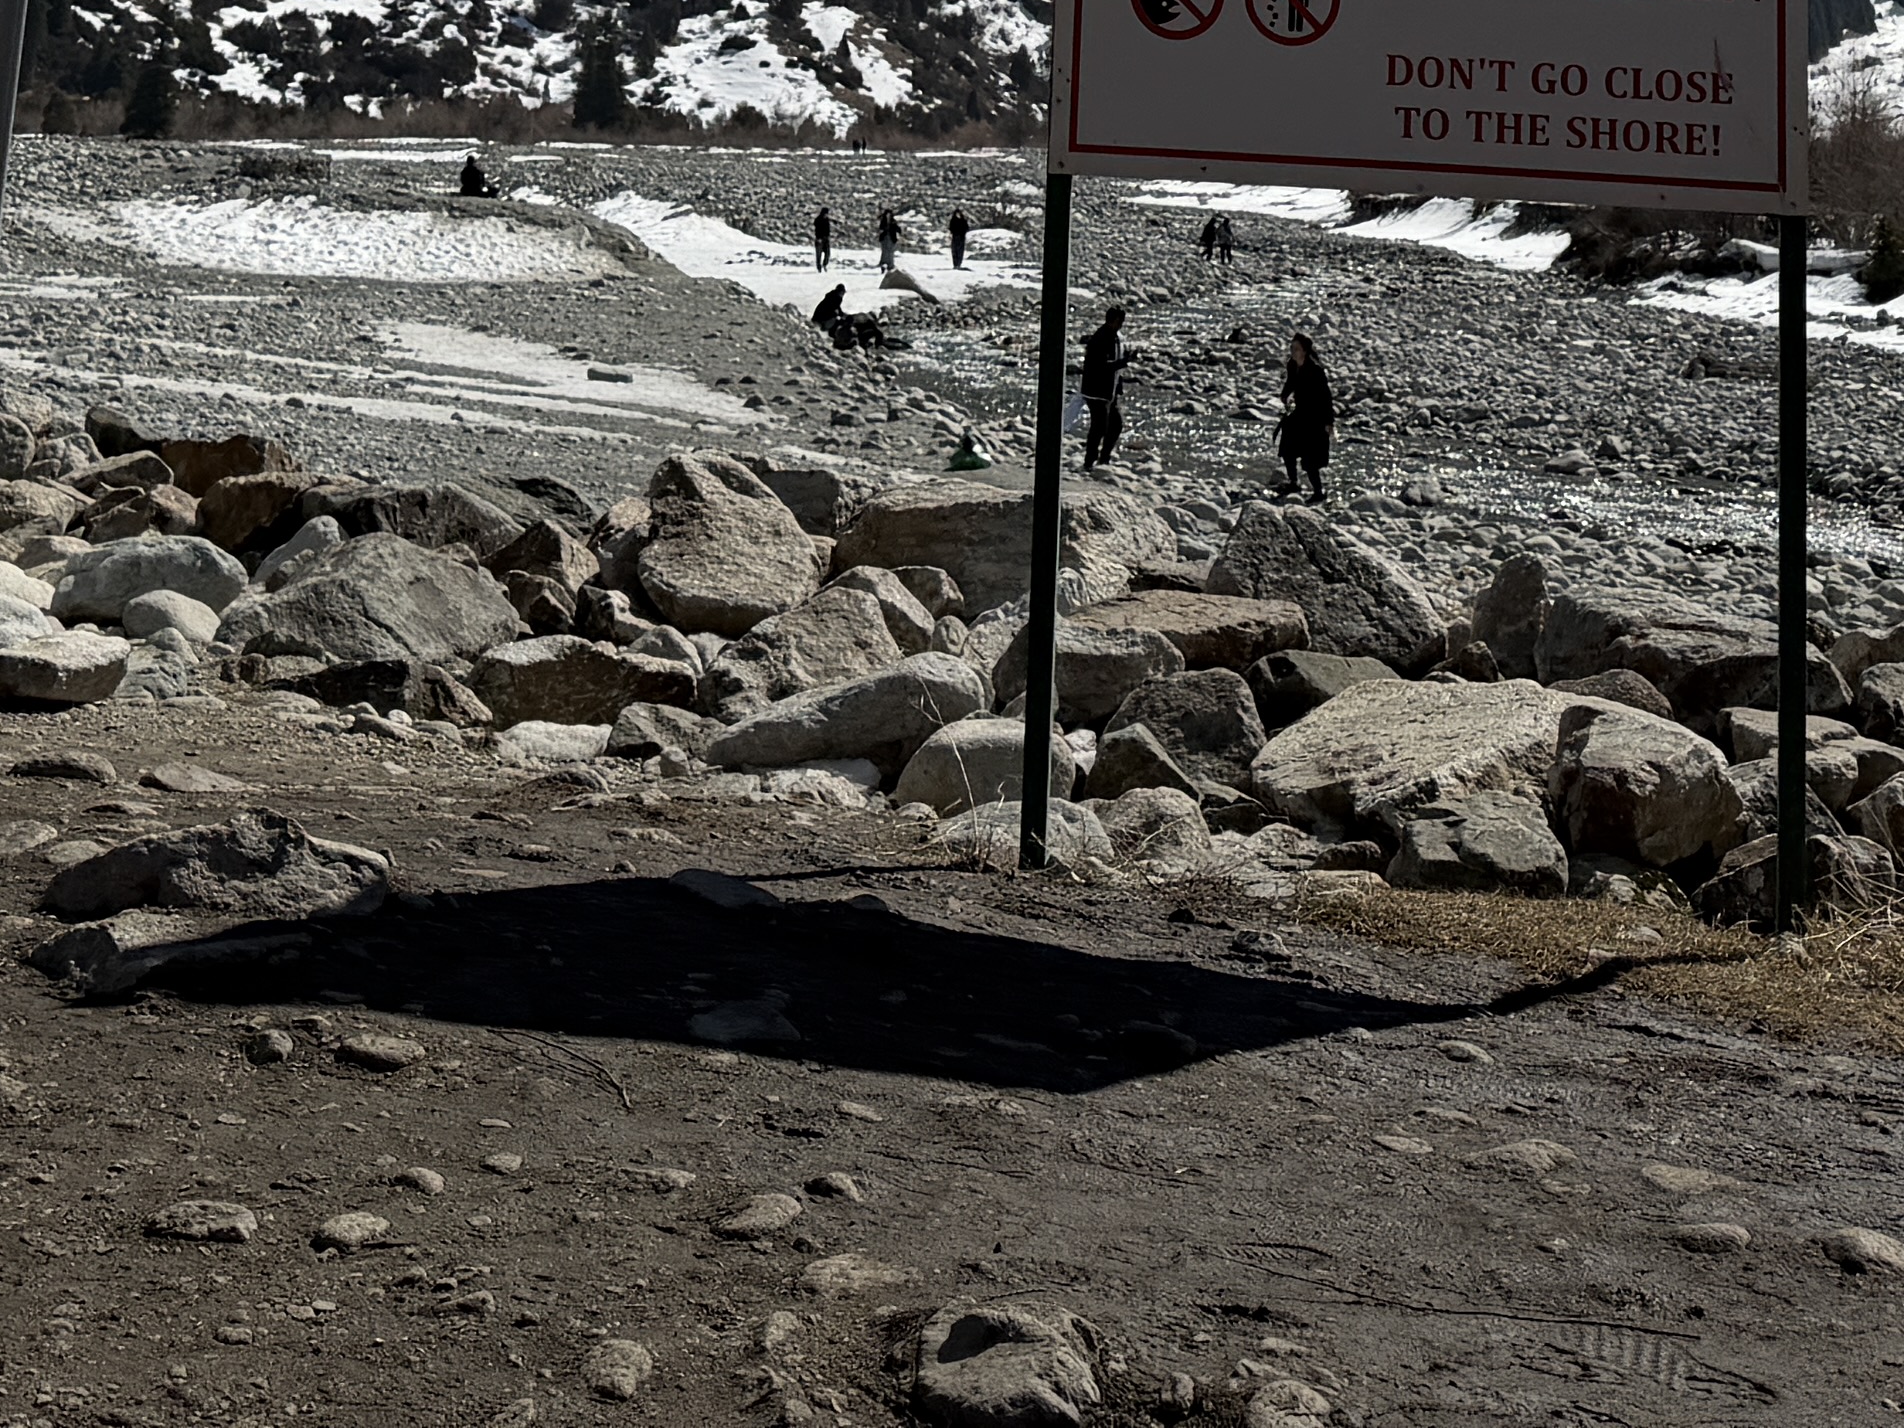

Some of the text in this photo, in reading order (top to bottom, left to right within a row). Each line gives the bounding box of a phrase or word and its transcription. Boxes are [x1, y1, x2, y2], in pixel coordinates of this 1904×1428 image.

[1385, 54, 1734, 106] DON'T GO CLOSE
[1395, 106, 1722, 157] TO THE SHORE!
